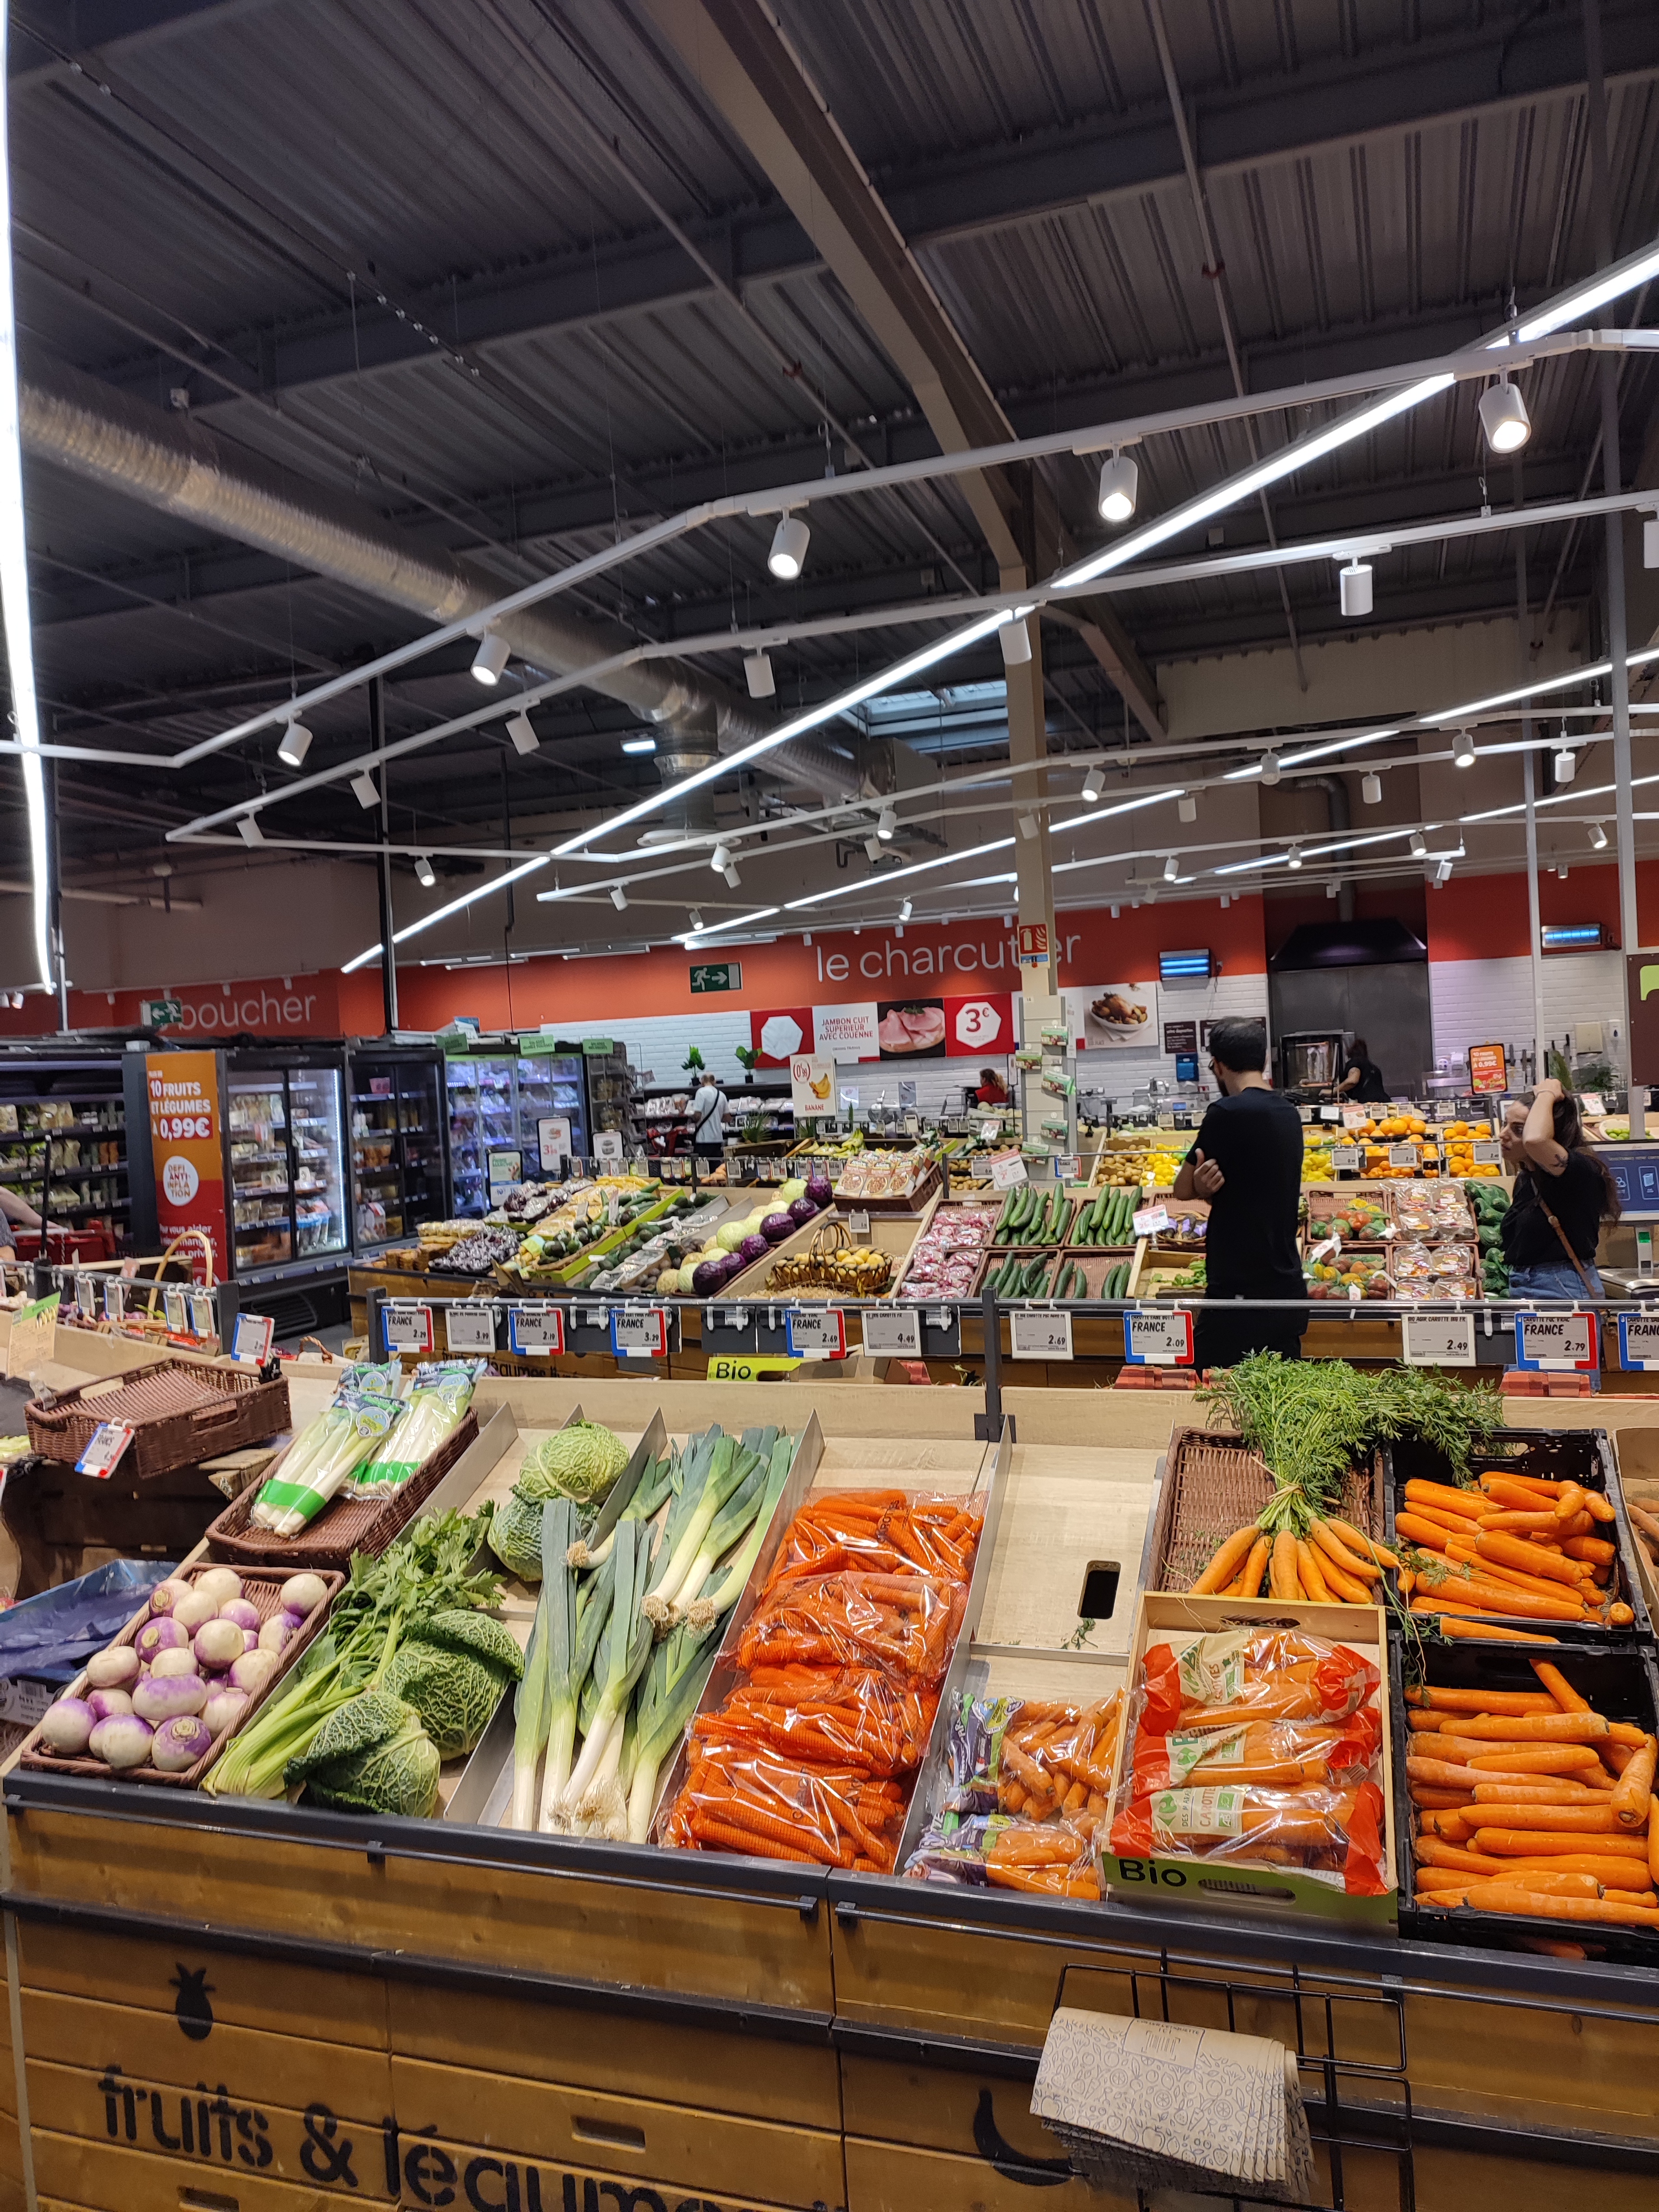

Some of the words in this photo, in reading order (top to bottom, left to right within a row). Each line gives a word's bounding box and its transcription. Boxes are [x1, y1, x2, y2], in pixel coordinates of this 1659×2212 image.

[817, 945, 849, 983] le
[822, 1017, 851, 1026] JAMBON
[839, 1030, 873, 1040] COUENNE
[150, 1080, 162, 1098] 10
[163, 1081, 202, 1097] FRUITS
[150, 1100, 159, 1115] ET
[160, 1098, 211, 1115] LÉGUMES
[160, 1117, 210, 1142] 0,99€
[388, 1316, 413, 1326] FRANCE
[516, 1318, 542, 1328] FRANCE
[617, 1318, 644, 1329] FRANCE
[792, 1319, 822, 1329] FRANCE
[1132, 1321, 1166, 1332] FRANCE
[1524, 1324, 1564, 1335] FRANCE
[822, 1332, 838, 1343] 2.69
[1048, 1334, 1066, 1345] 2.69
[1166, 1336, 1185, 1347] 2.09
[1446, 1339, 1468, 1351] 2.49
[1564, 1340, 1585, 1352] 2.79
[716, 1359, 751, 1380] Bio
[1119, 1859, 1187, 1887] Bio
[98, 2063, 274, 2168] fruits
[299, 2102, 359, 2188] &
